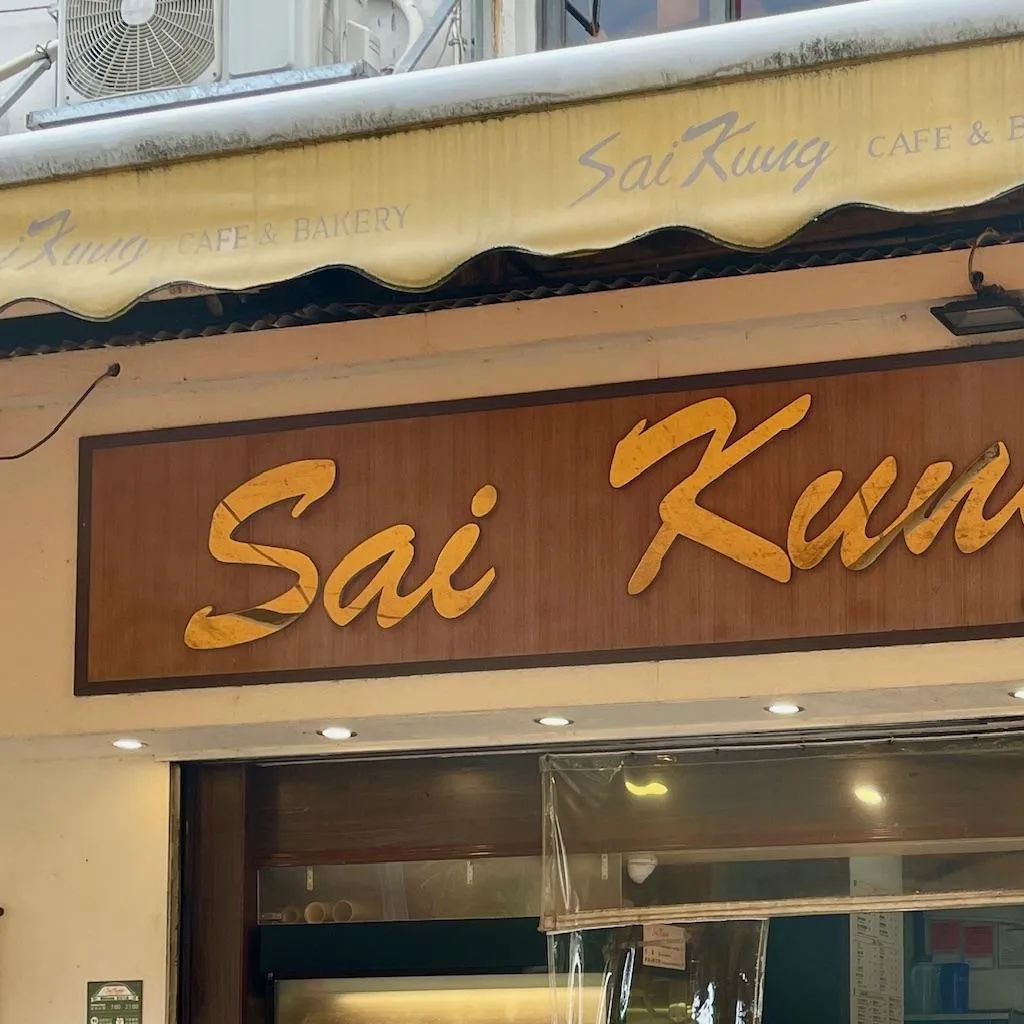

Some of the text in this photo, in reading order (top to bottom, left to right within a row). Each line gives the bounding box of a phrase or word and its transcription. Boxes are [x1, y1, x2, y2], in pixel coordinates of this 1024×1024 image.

[571, 131, 677, 207] Sai
[679, 110, 838, 194] Kung
[867, 125, 953, 159] CAFE
[967, 121, 992, 146] &
[177, 226, 249, 257] CAFE
[257, 220, 277, 246] &
[294, 205, 410, 244] BAKERY
[184, 459, 498, 652] Sai
